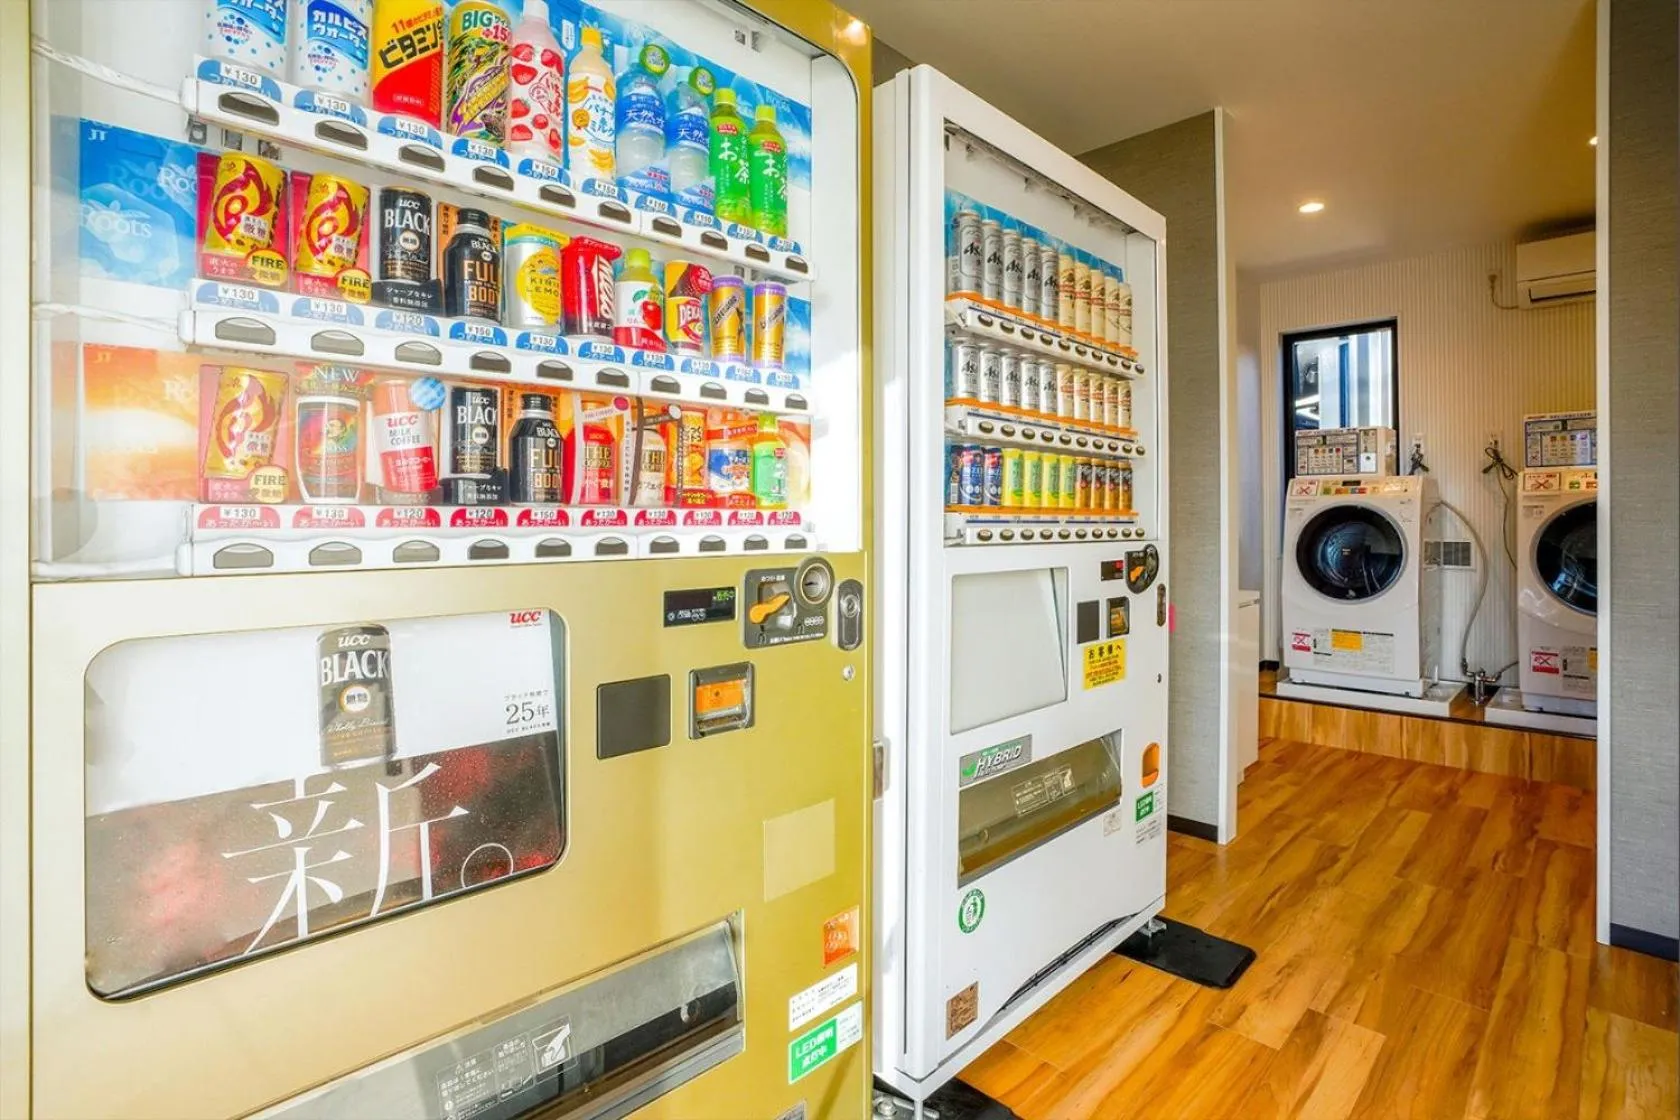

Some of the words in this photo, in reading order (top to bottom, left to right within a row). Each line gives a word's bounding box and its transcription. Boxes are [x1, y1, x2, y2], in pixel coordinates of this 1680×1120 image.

[462, 11, 492, 31] BIG
[224, 65, 258, 86] ¥130
[318, 96, 348, 112] ¥130
[88, 129, 107, 141] JT
[400, 121, 426, 135] ¥130
[677, 129, 708, 145] 天然
[384, 208, 431, 236] BLACK
[251, 256, 284, 270] FIRE
[341, 276, 370, 289] FIRE
[222, 286, 255, 300] ¥130
[526, 287, 560, 298] LEMO
[315, 302, 343, 313] ¥130
[313, 366, 360, 383] NEW
[255, 474, 287, 486] FIRE
[223, 507, 257, 518] ¥130
[467, 508, 493, 518] ¥120
[321, 649, 389, 686] BLACK
[506, 701, 551, 725] 25年
[976, 744, 1022, 777] HYBRID
